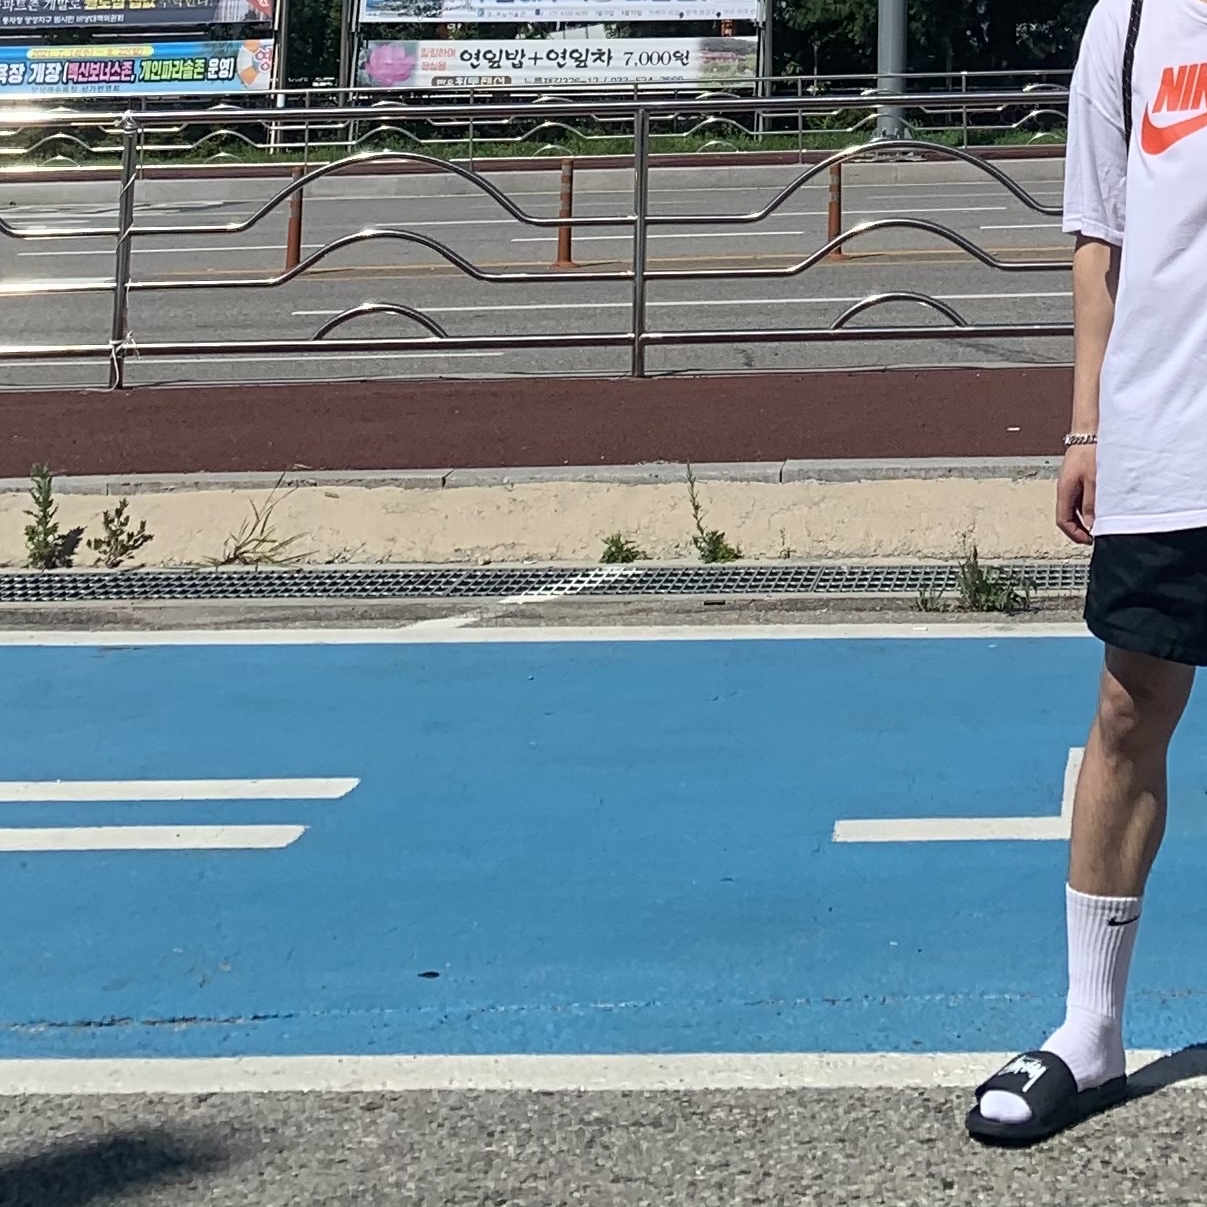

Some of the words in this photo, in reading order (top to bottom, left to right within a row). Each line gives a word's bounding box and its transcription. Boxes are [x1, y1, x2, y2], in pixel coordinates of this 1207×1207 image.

[460, 47, 613, 70] 연잎밥+연잎차
[623, 49, 690, 68] 7,000원
[29, 62, 62, 84] 개장
